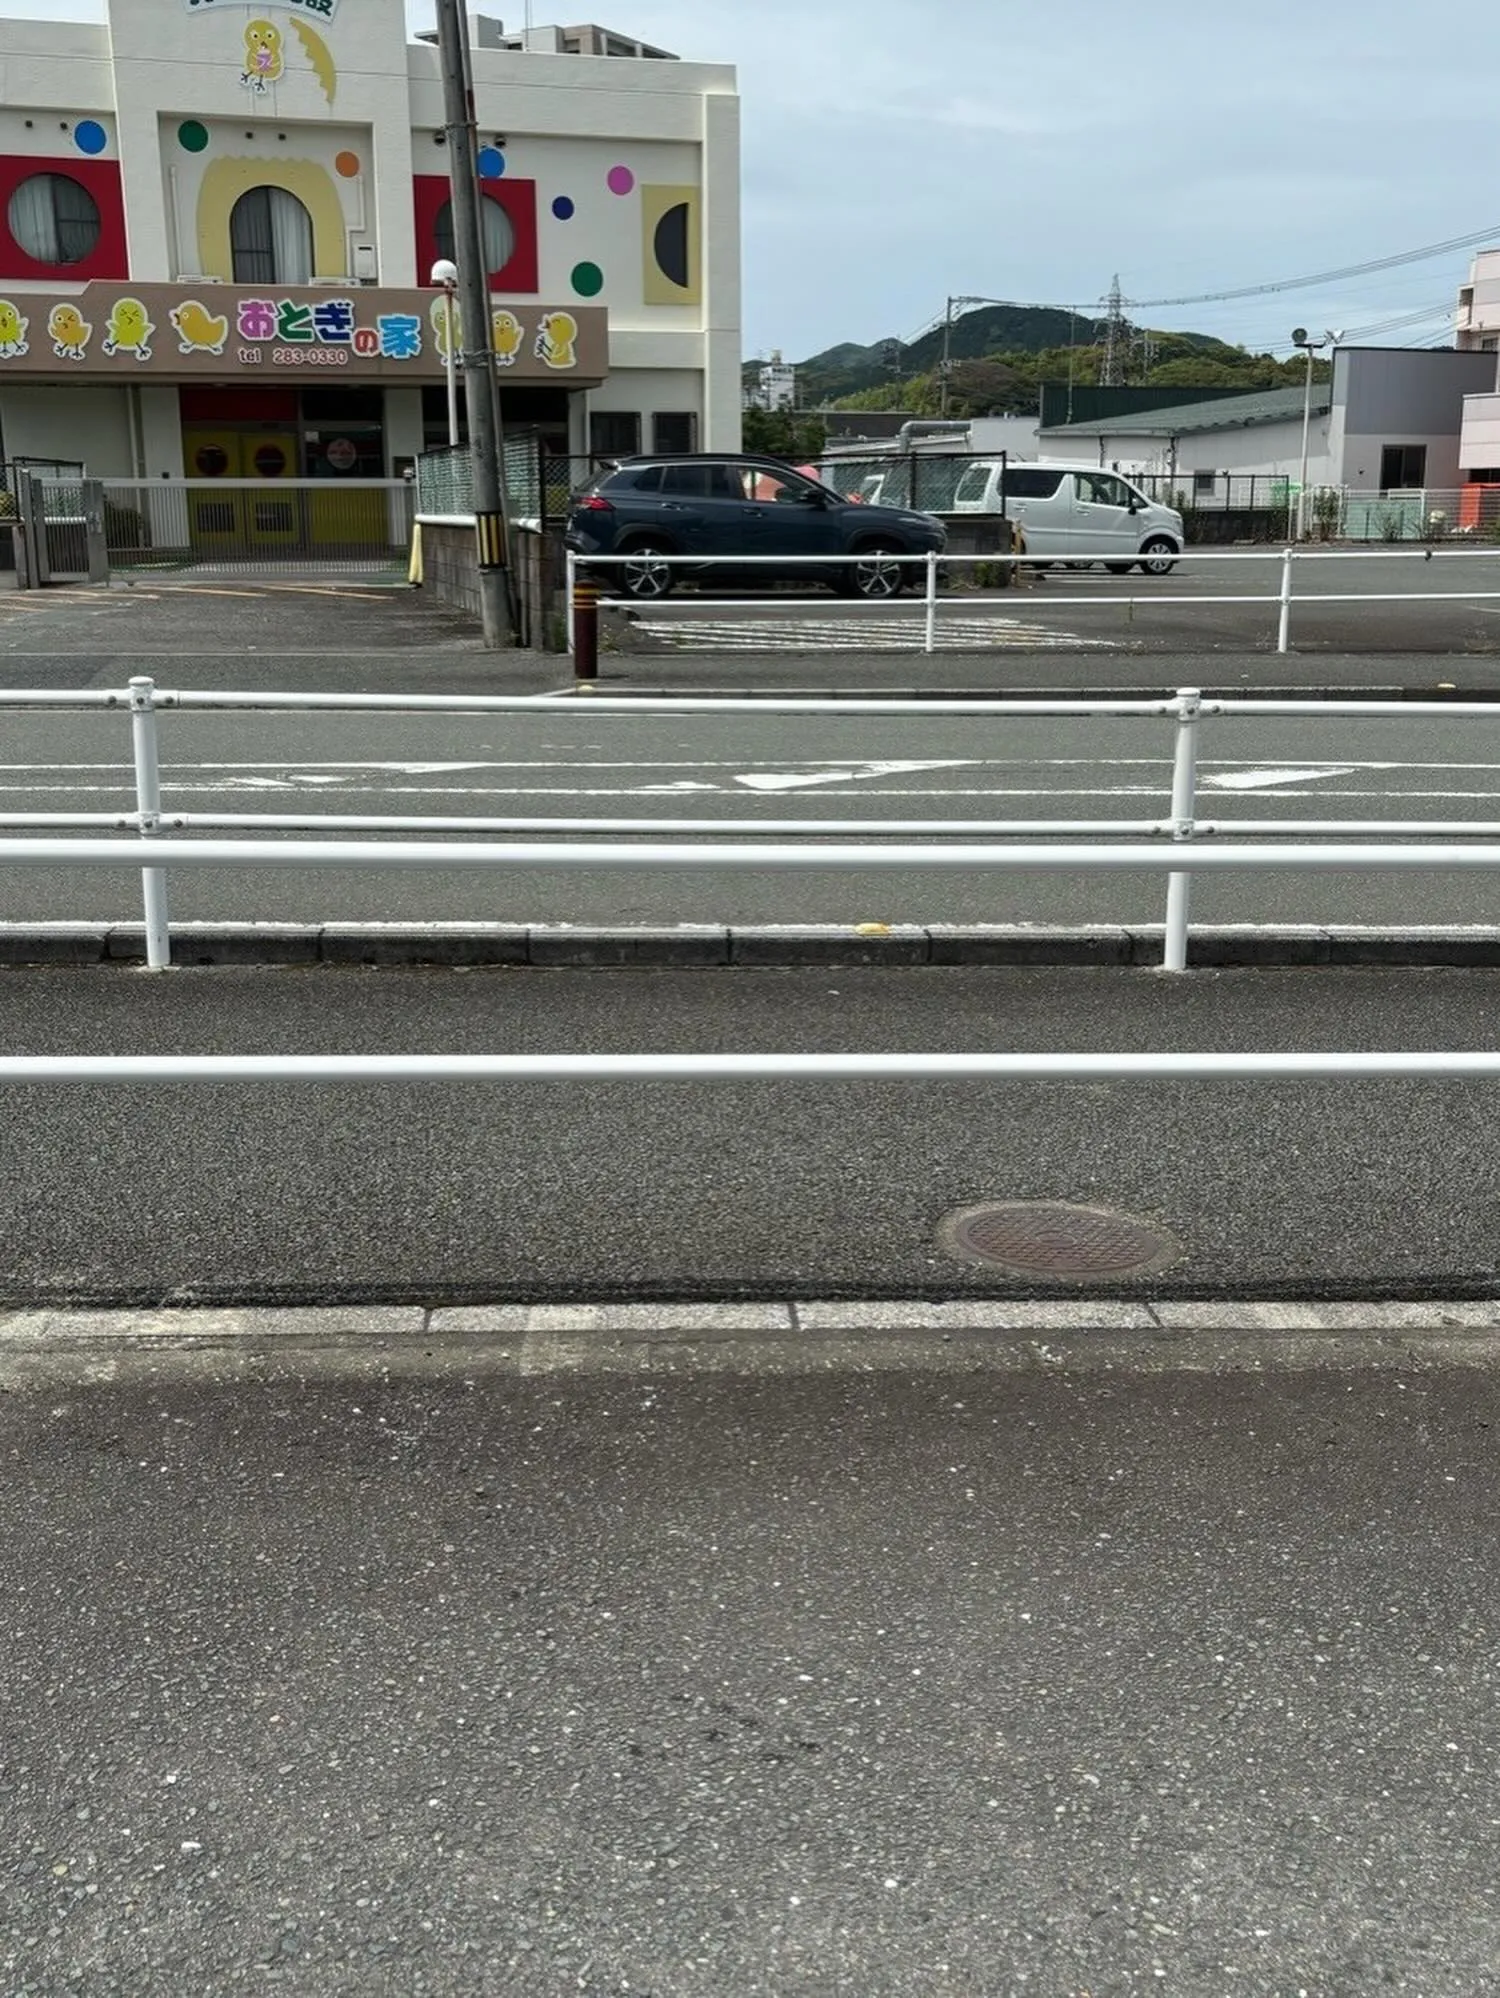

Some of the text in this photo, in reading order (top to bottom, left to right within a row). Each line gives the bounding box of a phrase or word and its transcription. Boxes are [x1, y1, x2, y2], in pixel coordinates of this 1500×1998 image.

[238, 300, 421, 357] おとぎの家
[238, 348, 348, 364] tel 283-0330
